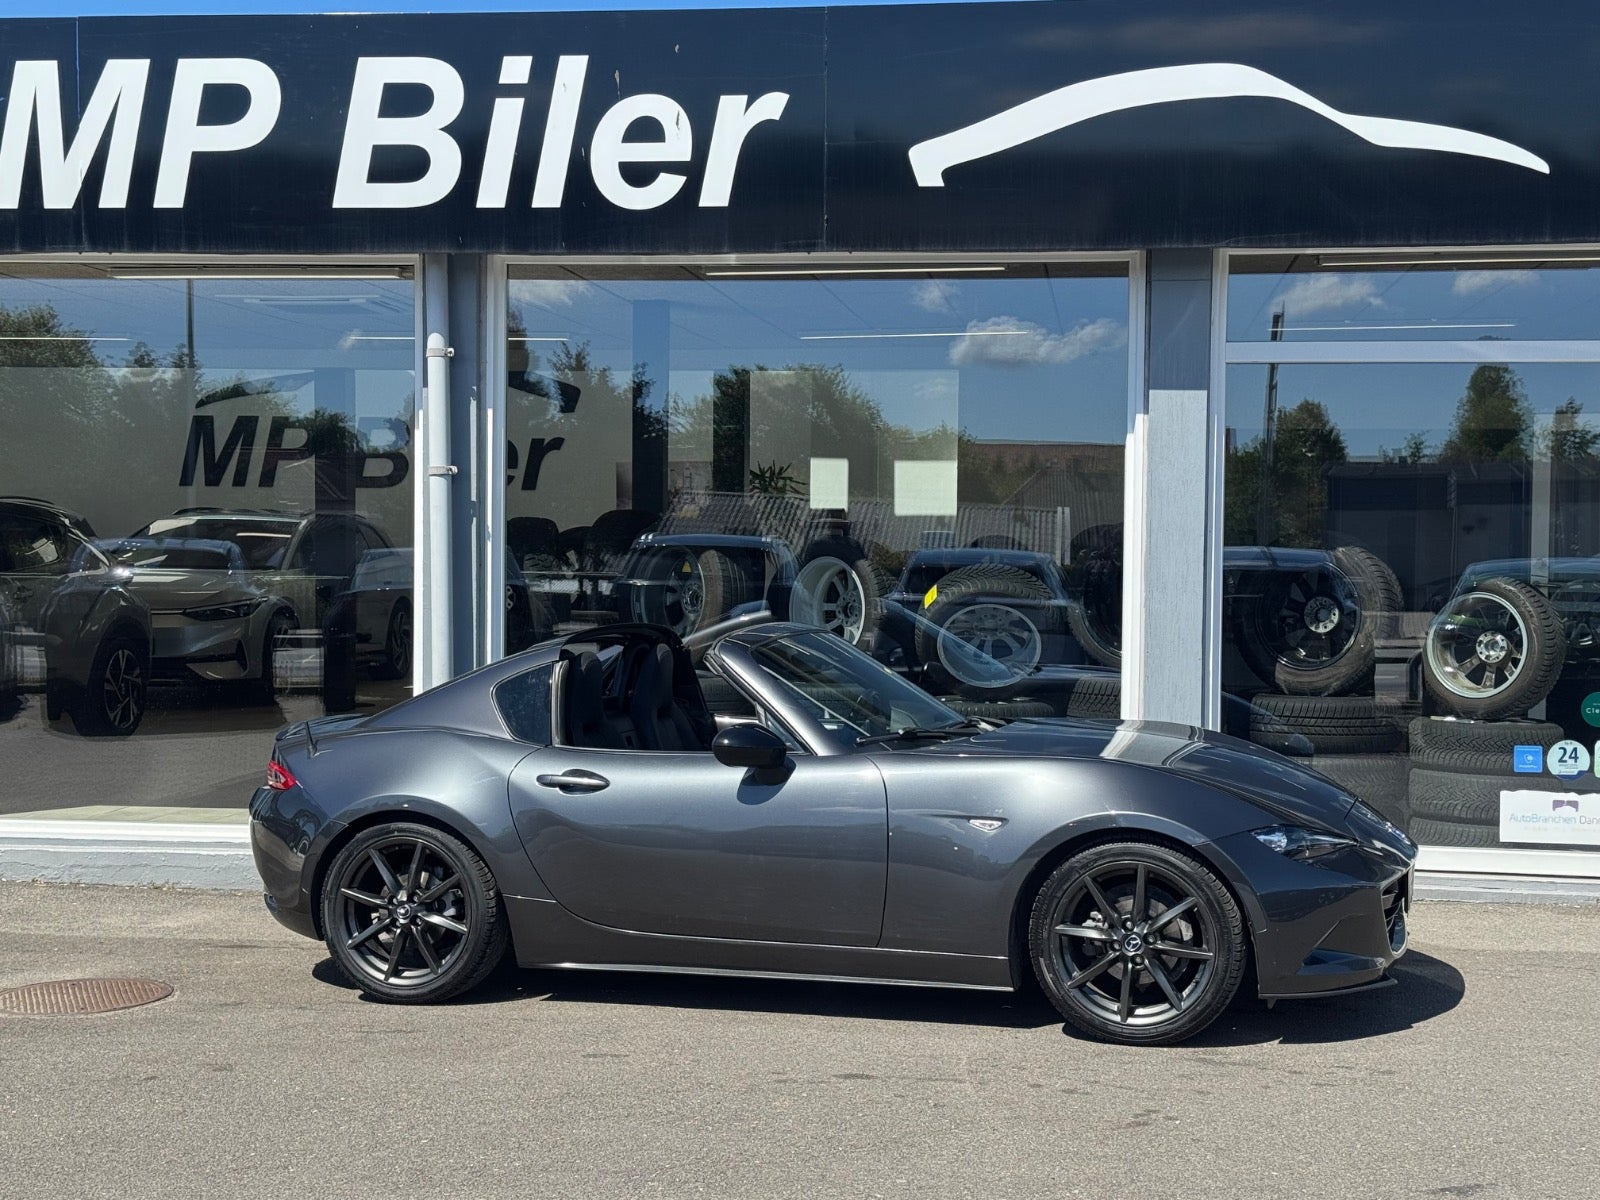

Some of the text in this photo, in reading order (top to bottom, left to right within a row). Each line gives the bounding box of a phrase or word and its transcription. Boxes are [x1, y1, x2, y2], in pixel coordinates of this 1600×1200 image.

[0, 54, 790, 211] MP Biler
[179, 415, 316, 488] MP
[1557, 746, 1579, 764] 24
[1509, 813, 1577, 824] AutoBranchen
